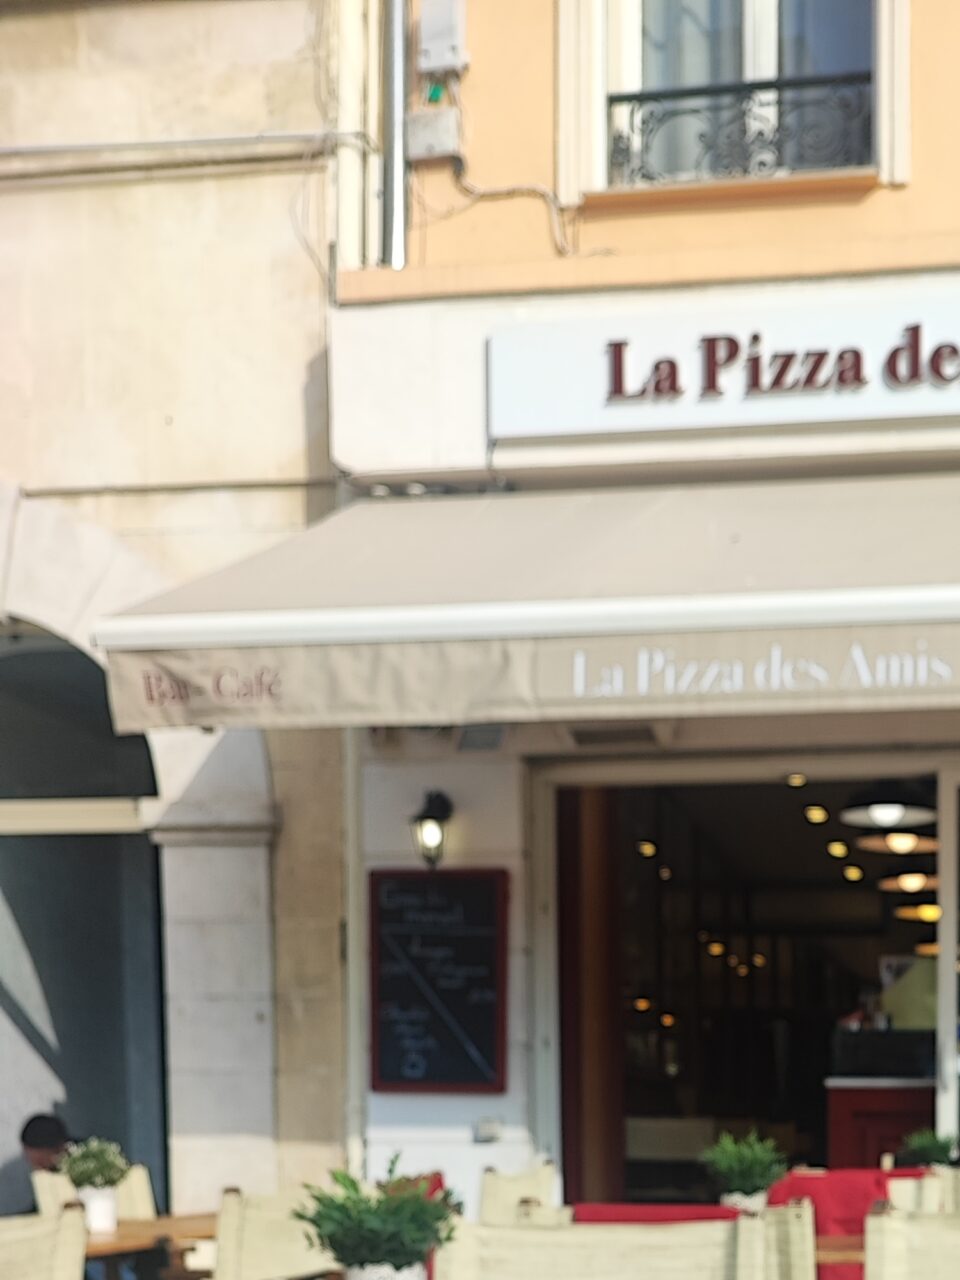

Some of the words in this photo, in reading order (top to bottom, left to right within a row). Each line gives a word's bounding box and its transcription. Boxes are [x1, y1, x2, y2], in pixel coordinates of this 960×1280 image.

[605, 339, 683, 405] La
[698, 332, 868, 401] Pizza
[212, 665, 282, 705] Café
[572, 647, 626, 699] La
[636, 645, 745, 697] Pizza
[753, 640, 830, 692] des
[840, 637, 954, 689] Amis
